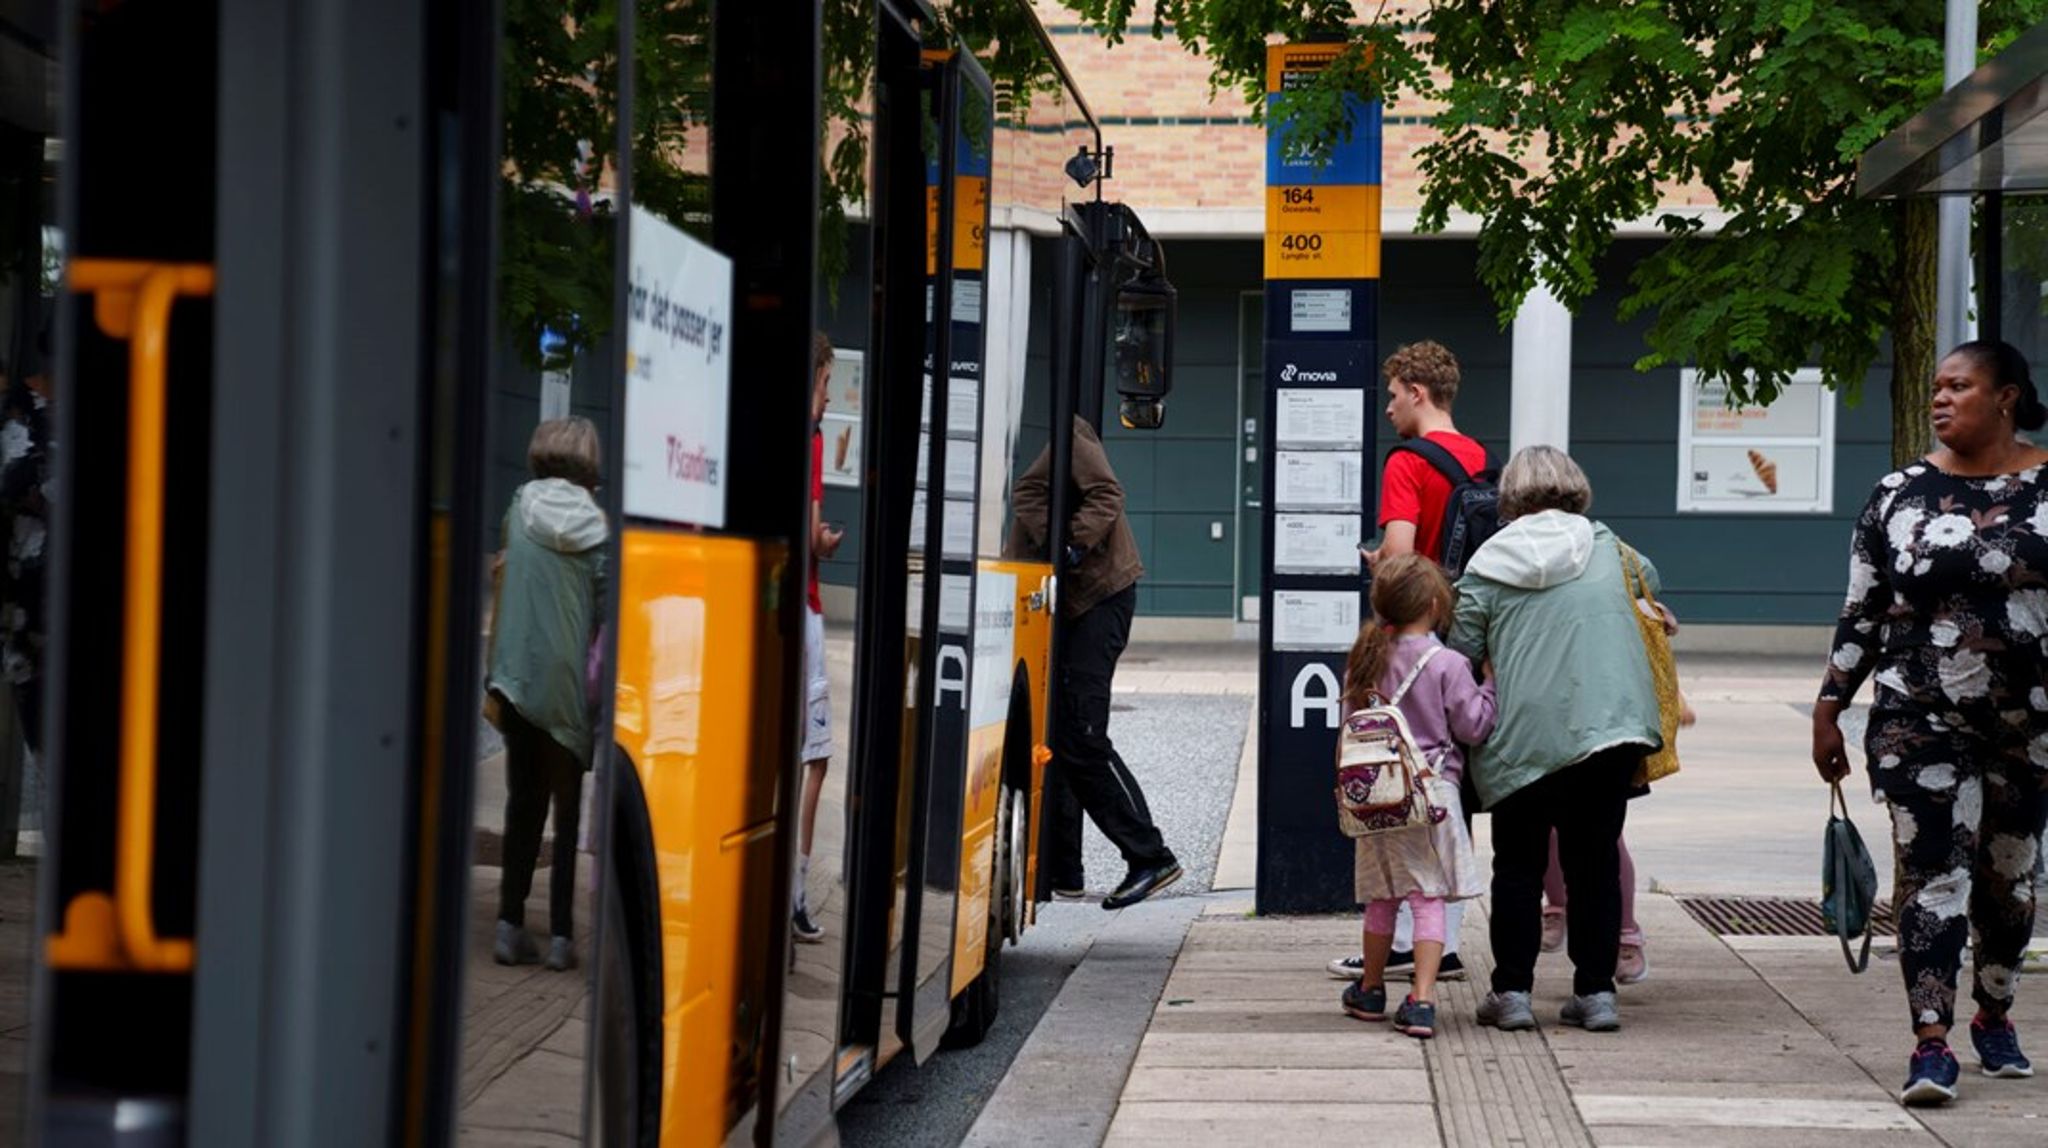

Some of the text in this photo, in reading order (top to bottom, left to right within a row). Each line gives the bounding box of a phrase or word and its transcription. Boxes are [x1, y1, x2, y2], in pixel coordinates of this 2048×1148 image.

[1282, 188, 1314, 204] 164
[1282, 234, 1322, 251] 400
[652, 278, 669, 333] det
[671, 302, 707, 350] passer
[706, 304, 722, 364] jer
[1298, 372, 1337, 382] movia
[1291, 662, 1340, 728] A
